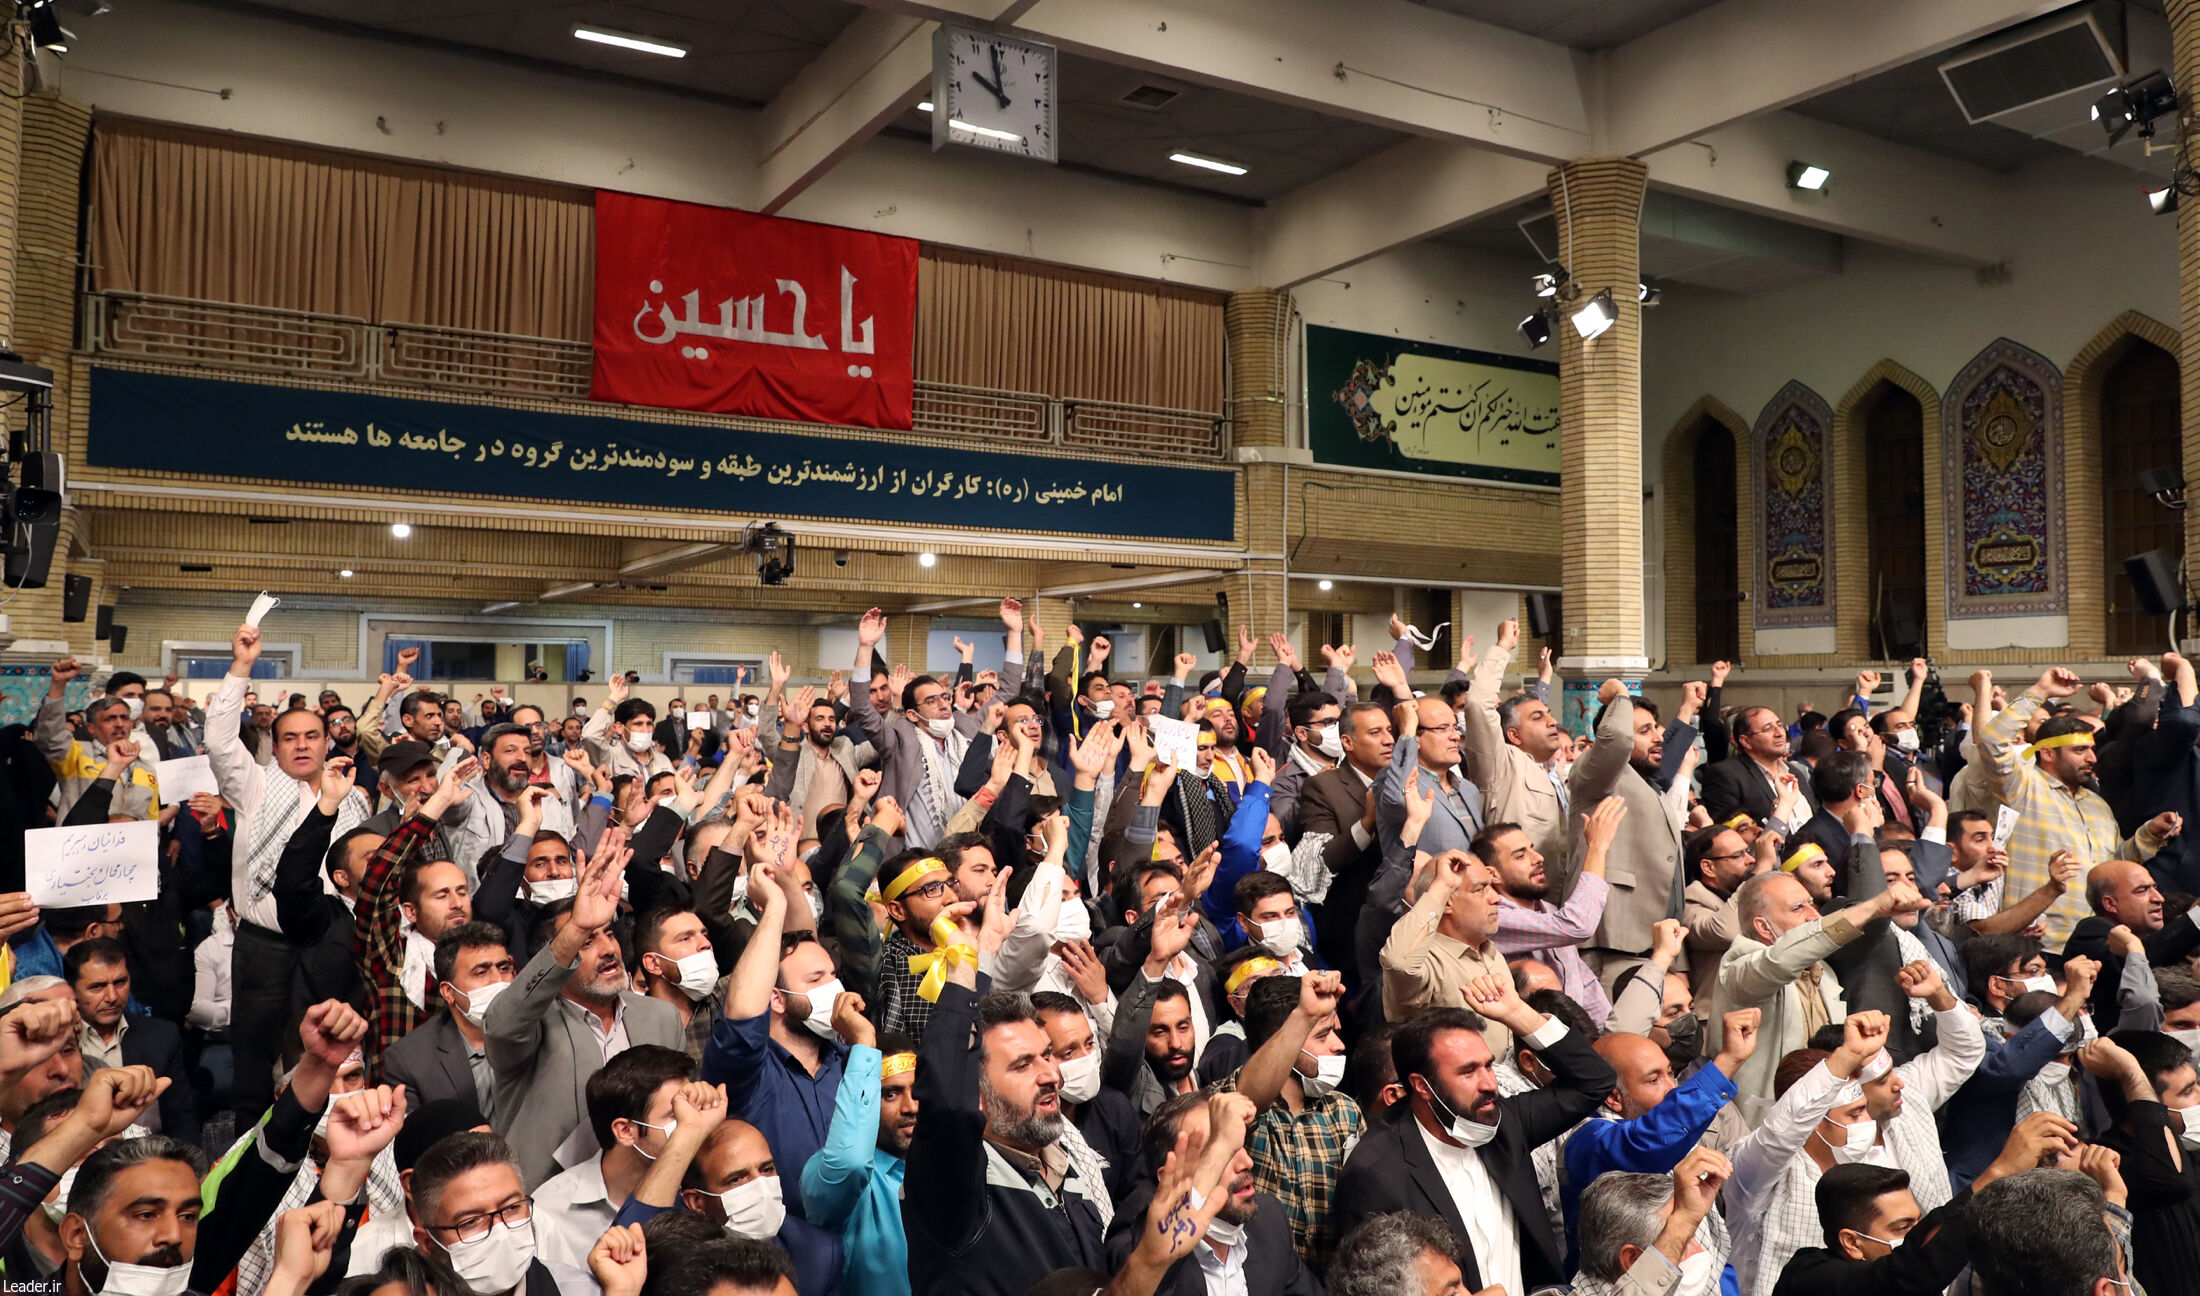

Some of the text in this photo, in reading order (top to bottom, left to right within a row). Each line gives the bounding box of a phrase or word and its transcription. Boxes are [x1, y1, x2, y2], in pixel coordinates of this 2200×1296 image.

[956, 80, 962, 93] ۹
[1021, 136, 1029, 148] ۵
[633, 263, 875, 378] یا حسین
[285, 422, 359, 446] هستند
[366, 422, 392, 448] ها
[398, 428, 467, 460] جامعه
[474, 438, 505, 462] در
[510, 440, 564, 468] گروه
[569, 443, 695, 478] سودمندترین
[699, 459, 712, 480] و
[716, 453, 763, 482] طبقه
[767, 460, 884, 492] ارزشمندترین
[889, 468, 907, 493] از
[911, 470, 982, 499] کارگران
[1034, 479, 1087, 504] خمینی
[1091, 483, 1123, 506] امام
